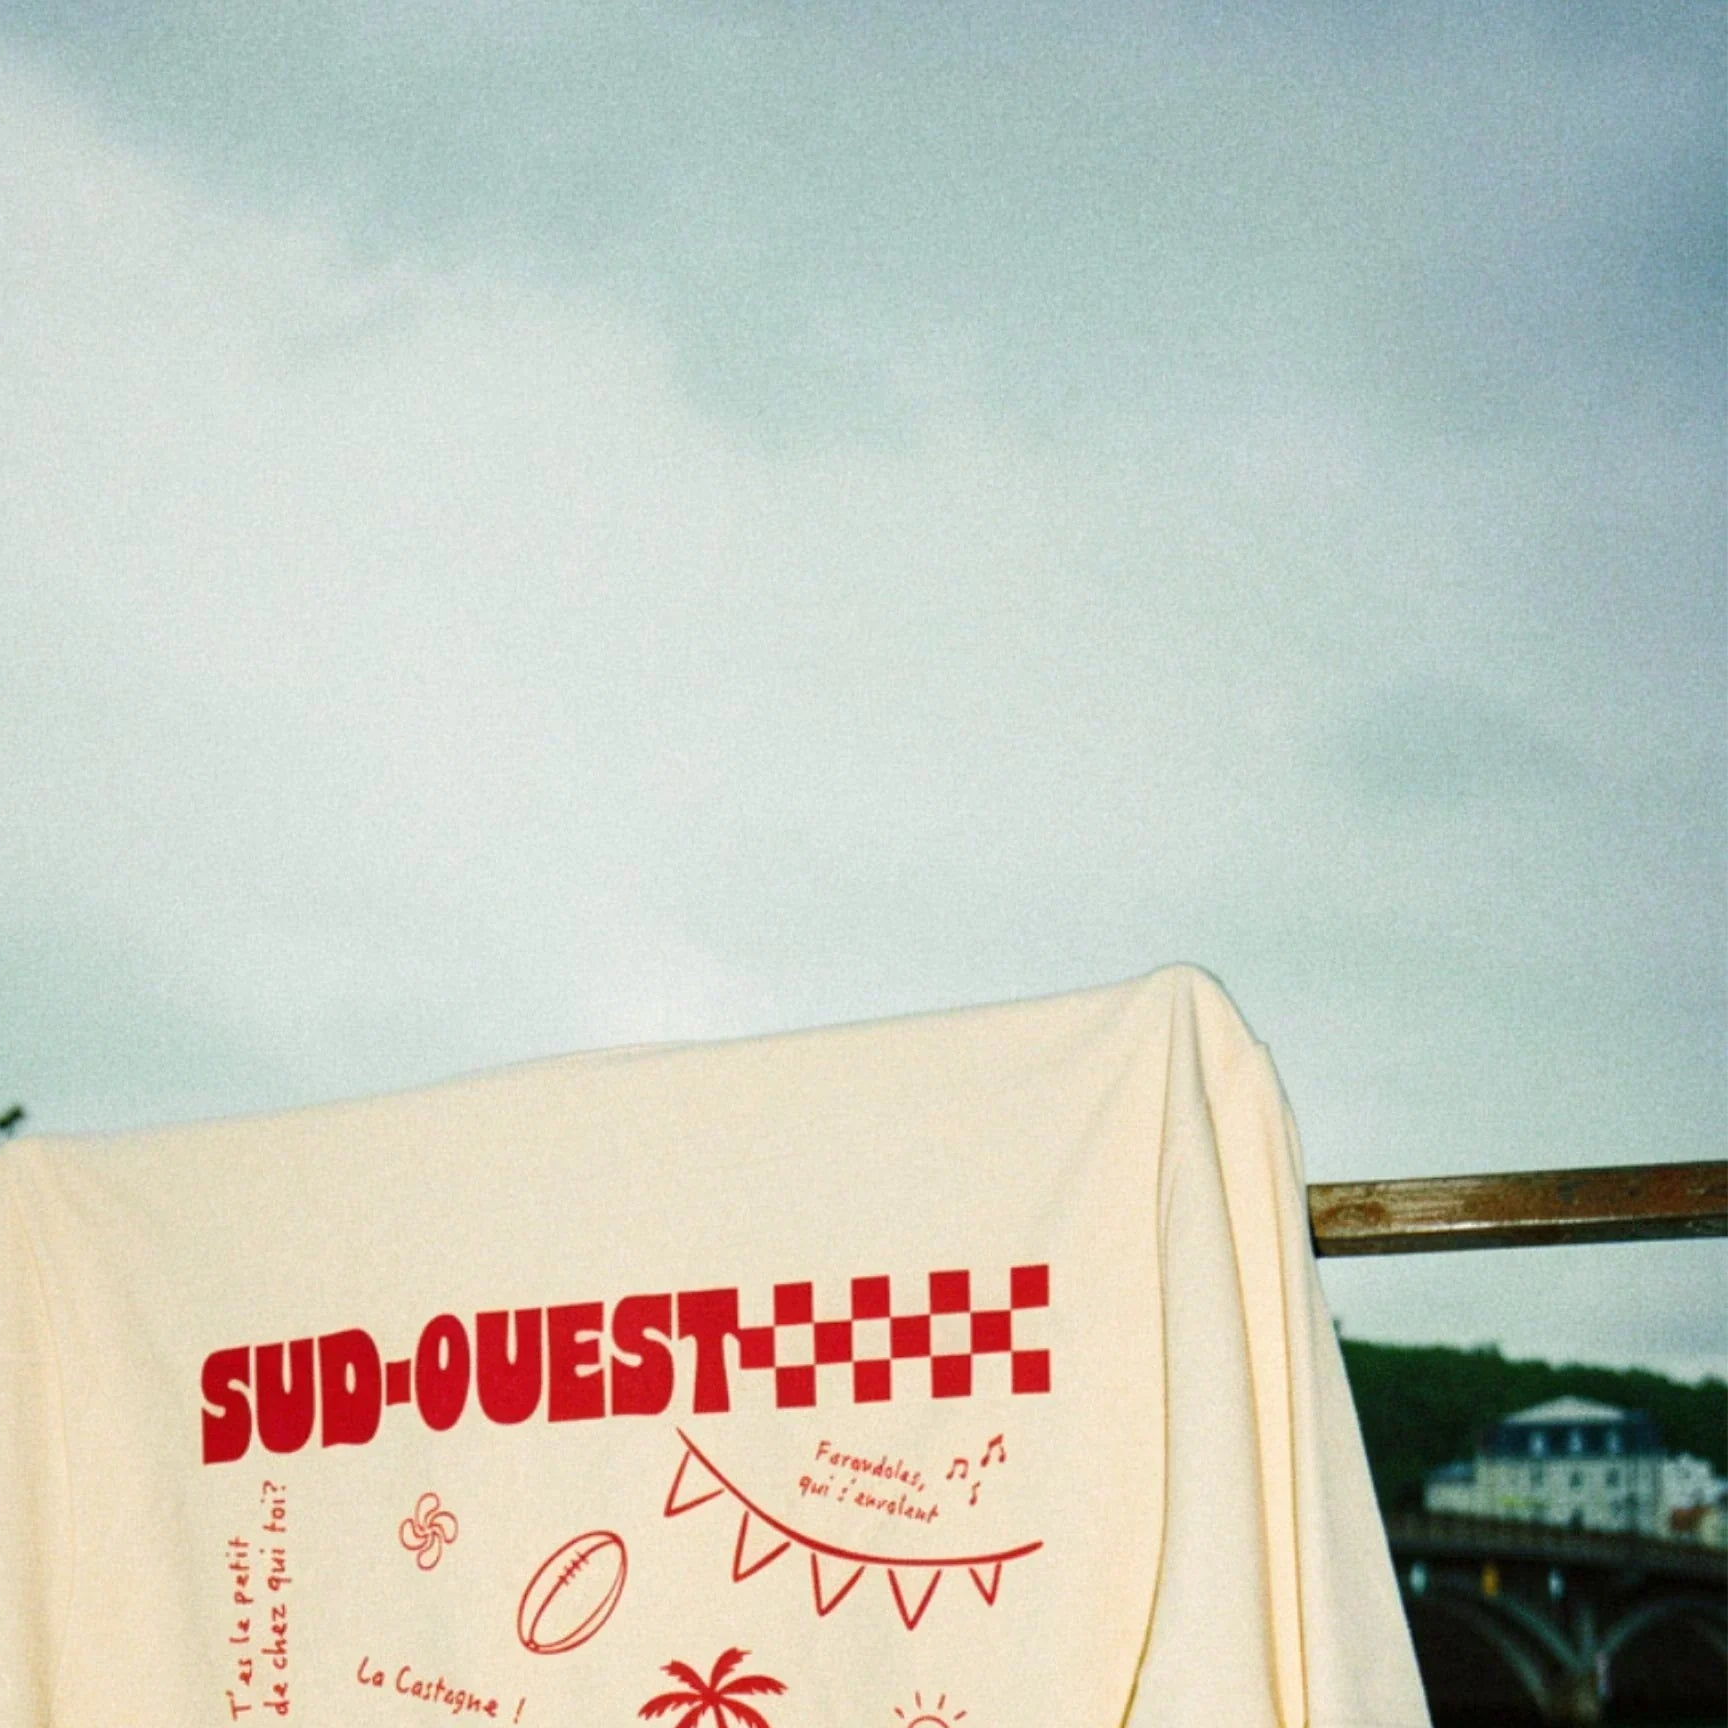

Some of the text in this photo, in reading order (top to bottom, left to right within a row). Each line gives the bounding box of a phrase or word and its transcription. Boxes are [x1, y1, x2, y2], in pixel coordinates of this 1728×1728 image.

[201, 1287, 740, 1465] SUD-OUEST
[225, 1536, 254, 1605] petit
[259, 1547, 293, 1592] qui
[261, 1603, 288, 1670] chez
[356, 1655, 385, 1687] La
